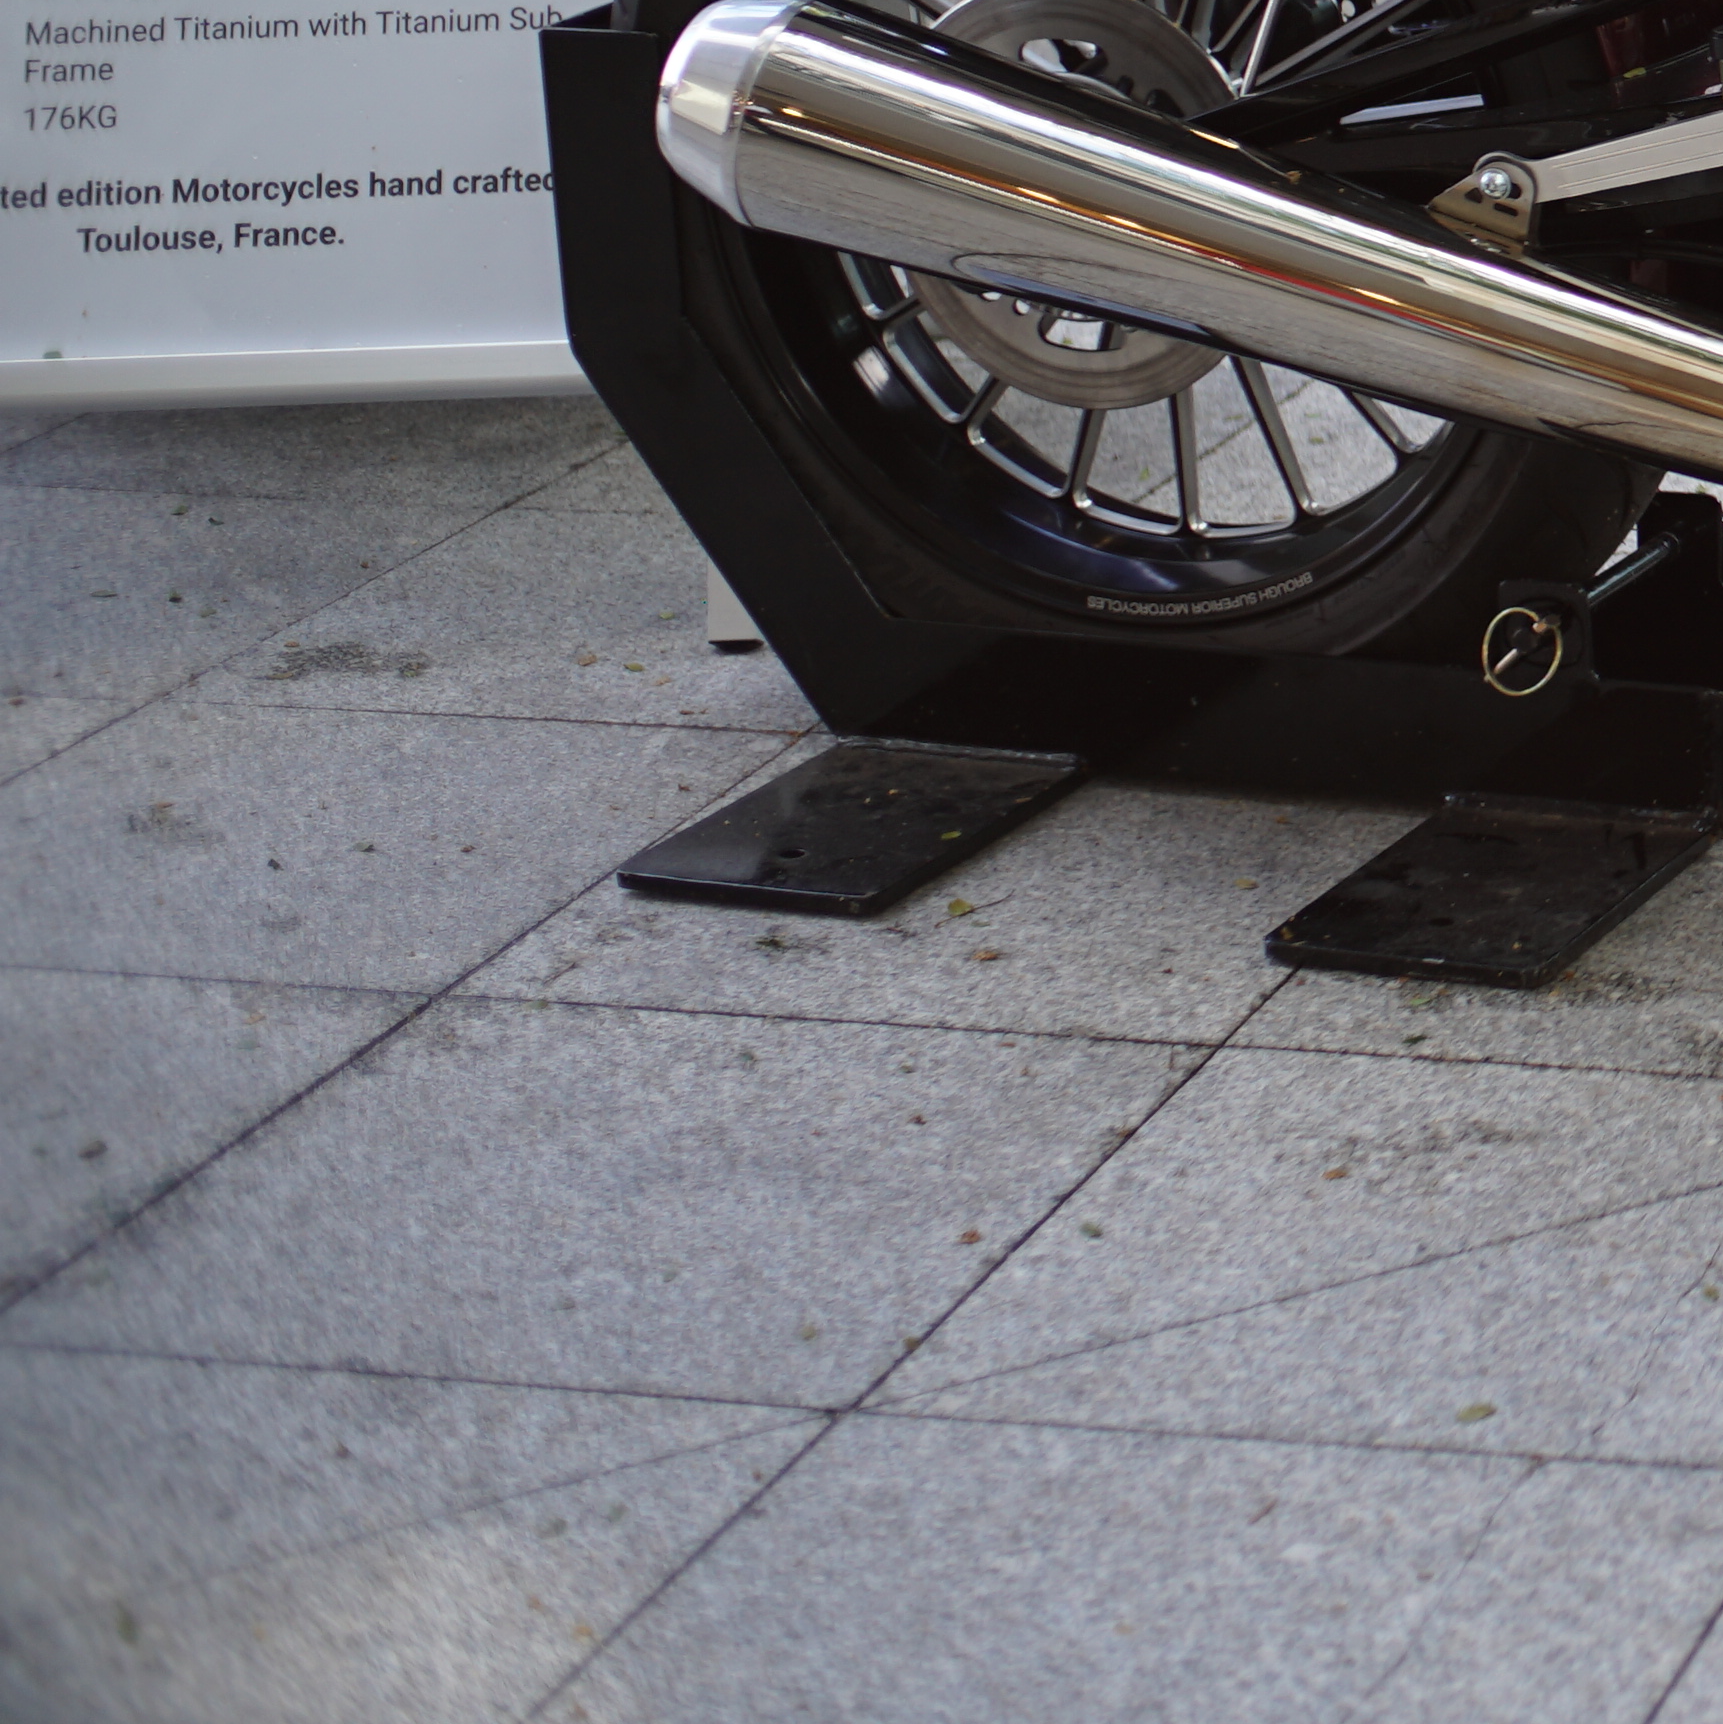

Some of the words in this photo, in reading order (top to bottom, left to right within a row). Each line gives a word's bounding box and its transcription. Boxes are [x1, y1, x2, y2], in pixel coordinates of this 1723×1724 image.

[25, 16, 166, 45] Machined
[173, 14, 300, 42] Titanium
[308, 11, 367, 38] with
[375, 8, 500, 35] Titanium
[24, 58, 114, 83] Frame
[24, 104, 118, 131] 176KG
[56, 179, 162, 208] edition
[171, 172, 360, 207] Motorcycles
[368, 168, 443, 198] hand
[76, 225, 224, 254] Toulouse,
[233, 223, 346, 248] France.
[1258, 571, 1314, 603] BROUGH
[1086, 594, 1189, 617] MOTORCYCLES
[1191, 590, 1258, 614] SUPERIOR
